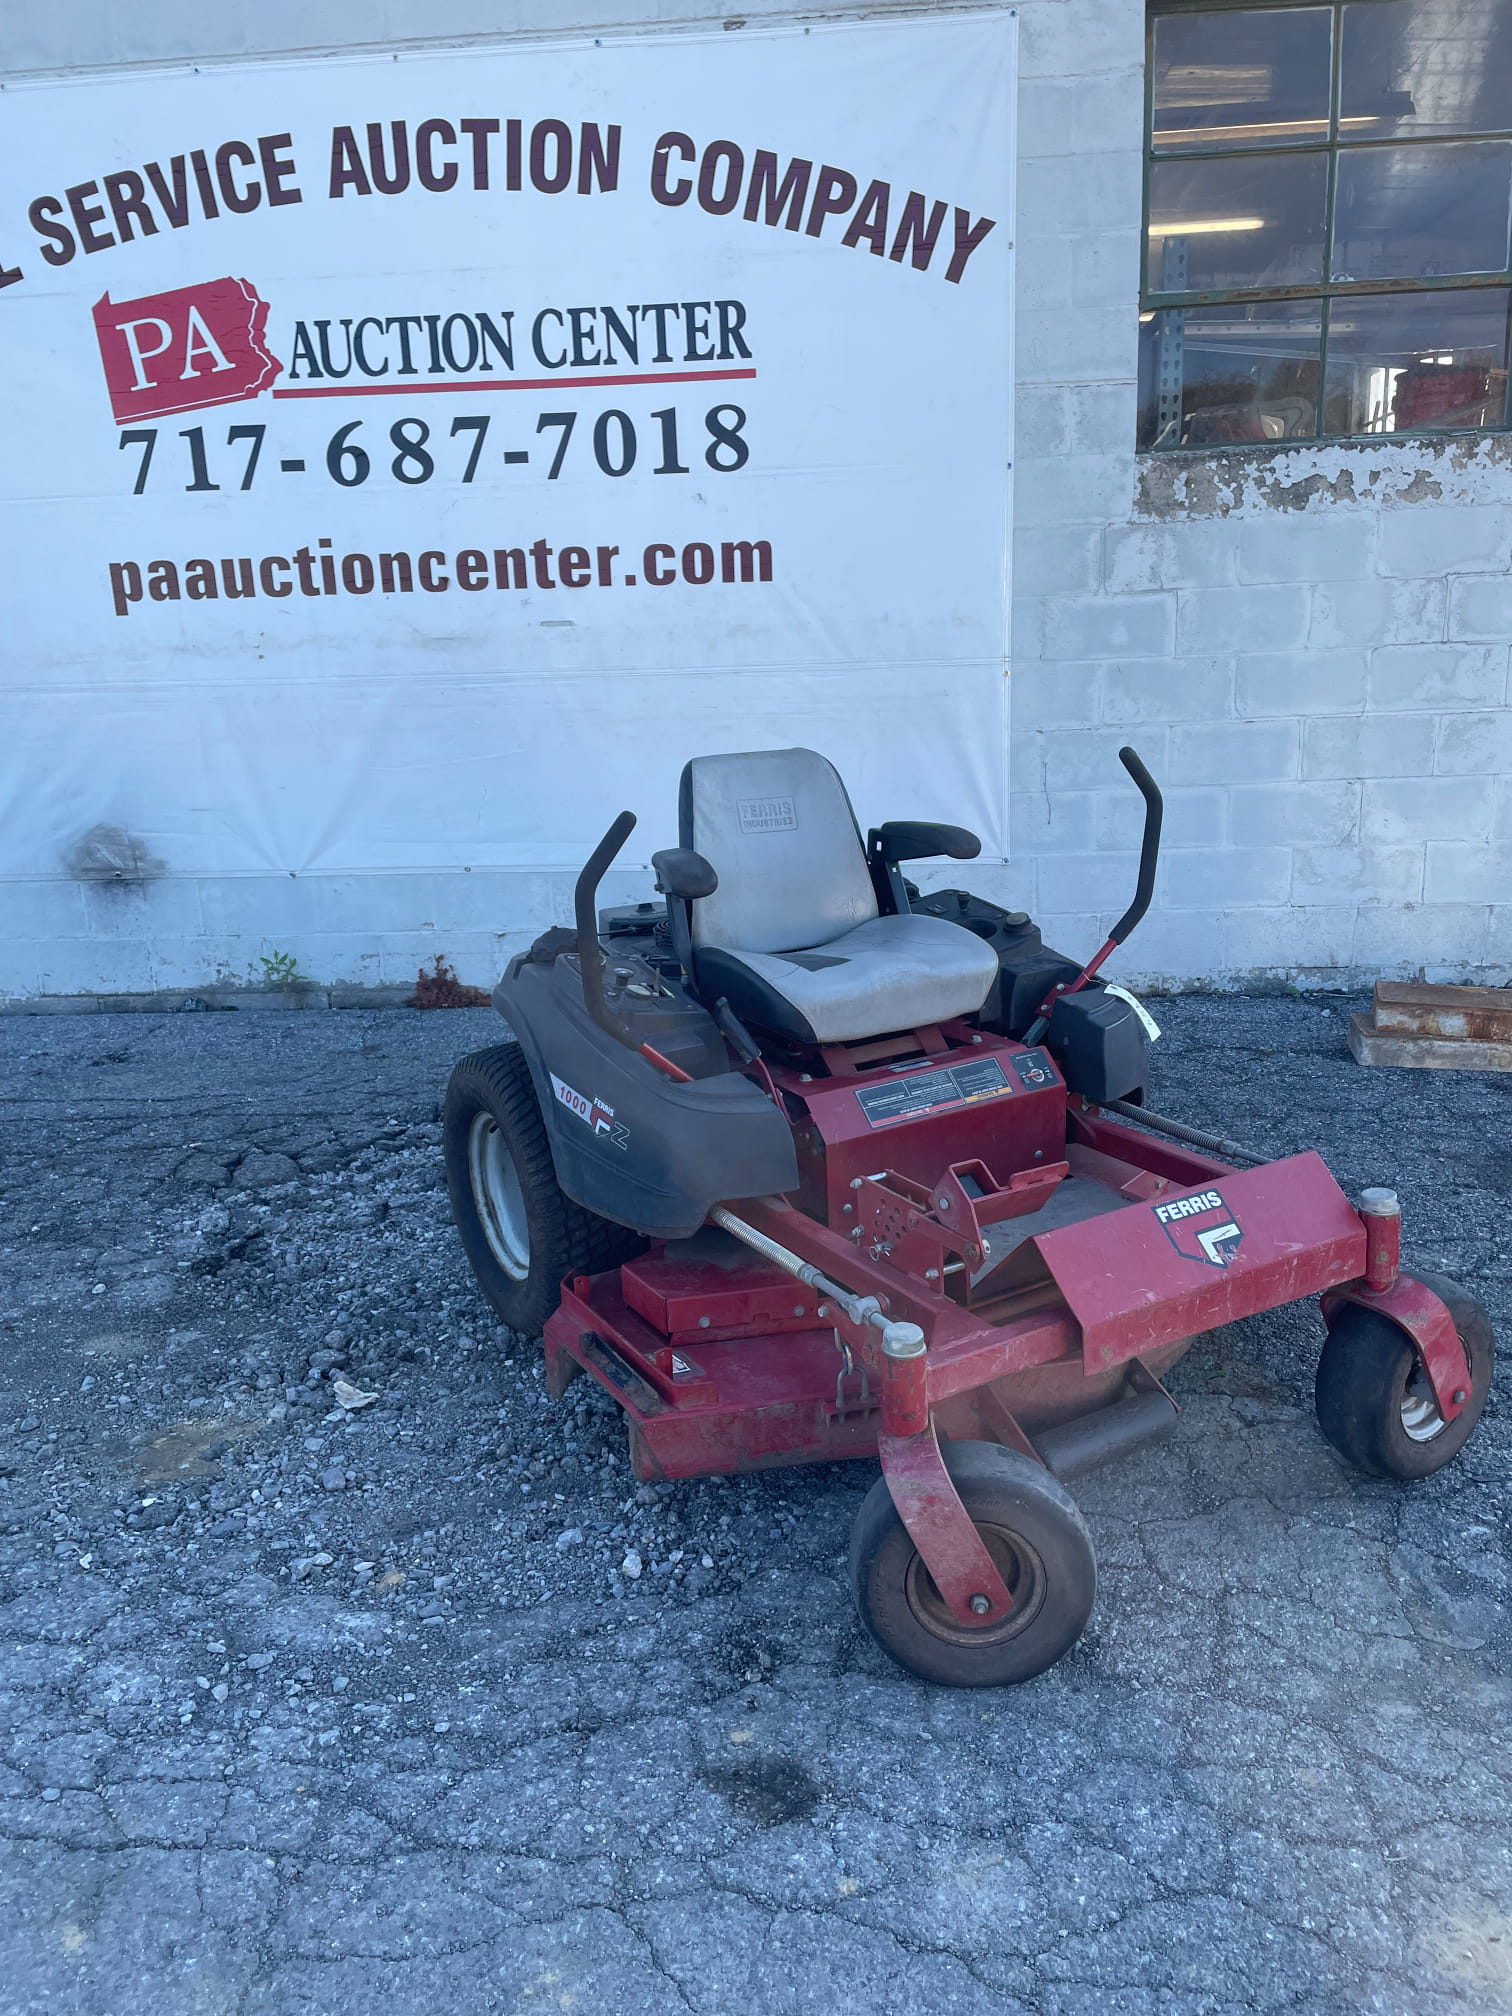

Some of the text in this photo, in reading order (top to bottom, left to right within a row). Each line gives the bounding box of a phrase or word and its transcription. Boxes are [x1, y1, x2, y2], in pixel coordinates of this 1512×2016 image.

[29, 119, 996, 284] SERVICE AUCTION COMPANY
[115, 305, 236, 391] PA
[289, 300, 752, 378] AUCTION CENTER
[118, 404, 749, 494] 717-687-7018
[109, 539, 773, 616] paauctioncenter.com
[560, 1086, 586, 1114] 1000
[594, 1097, 614, 1117] FERRIS
[1155, 1191, 1222, 1223] FERRIS
